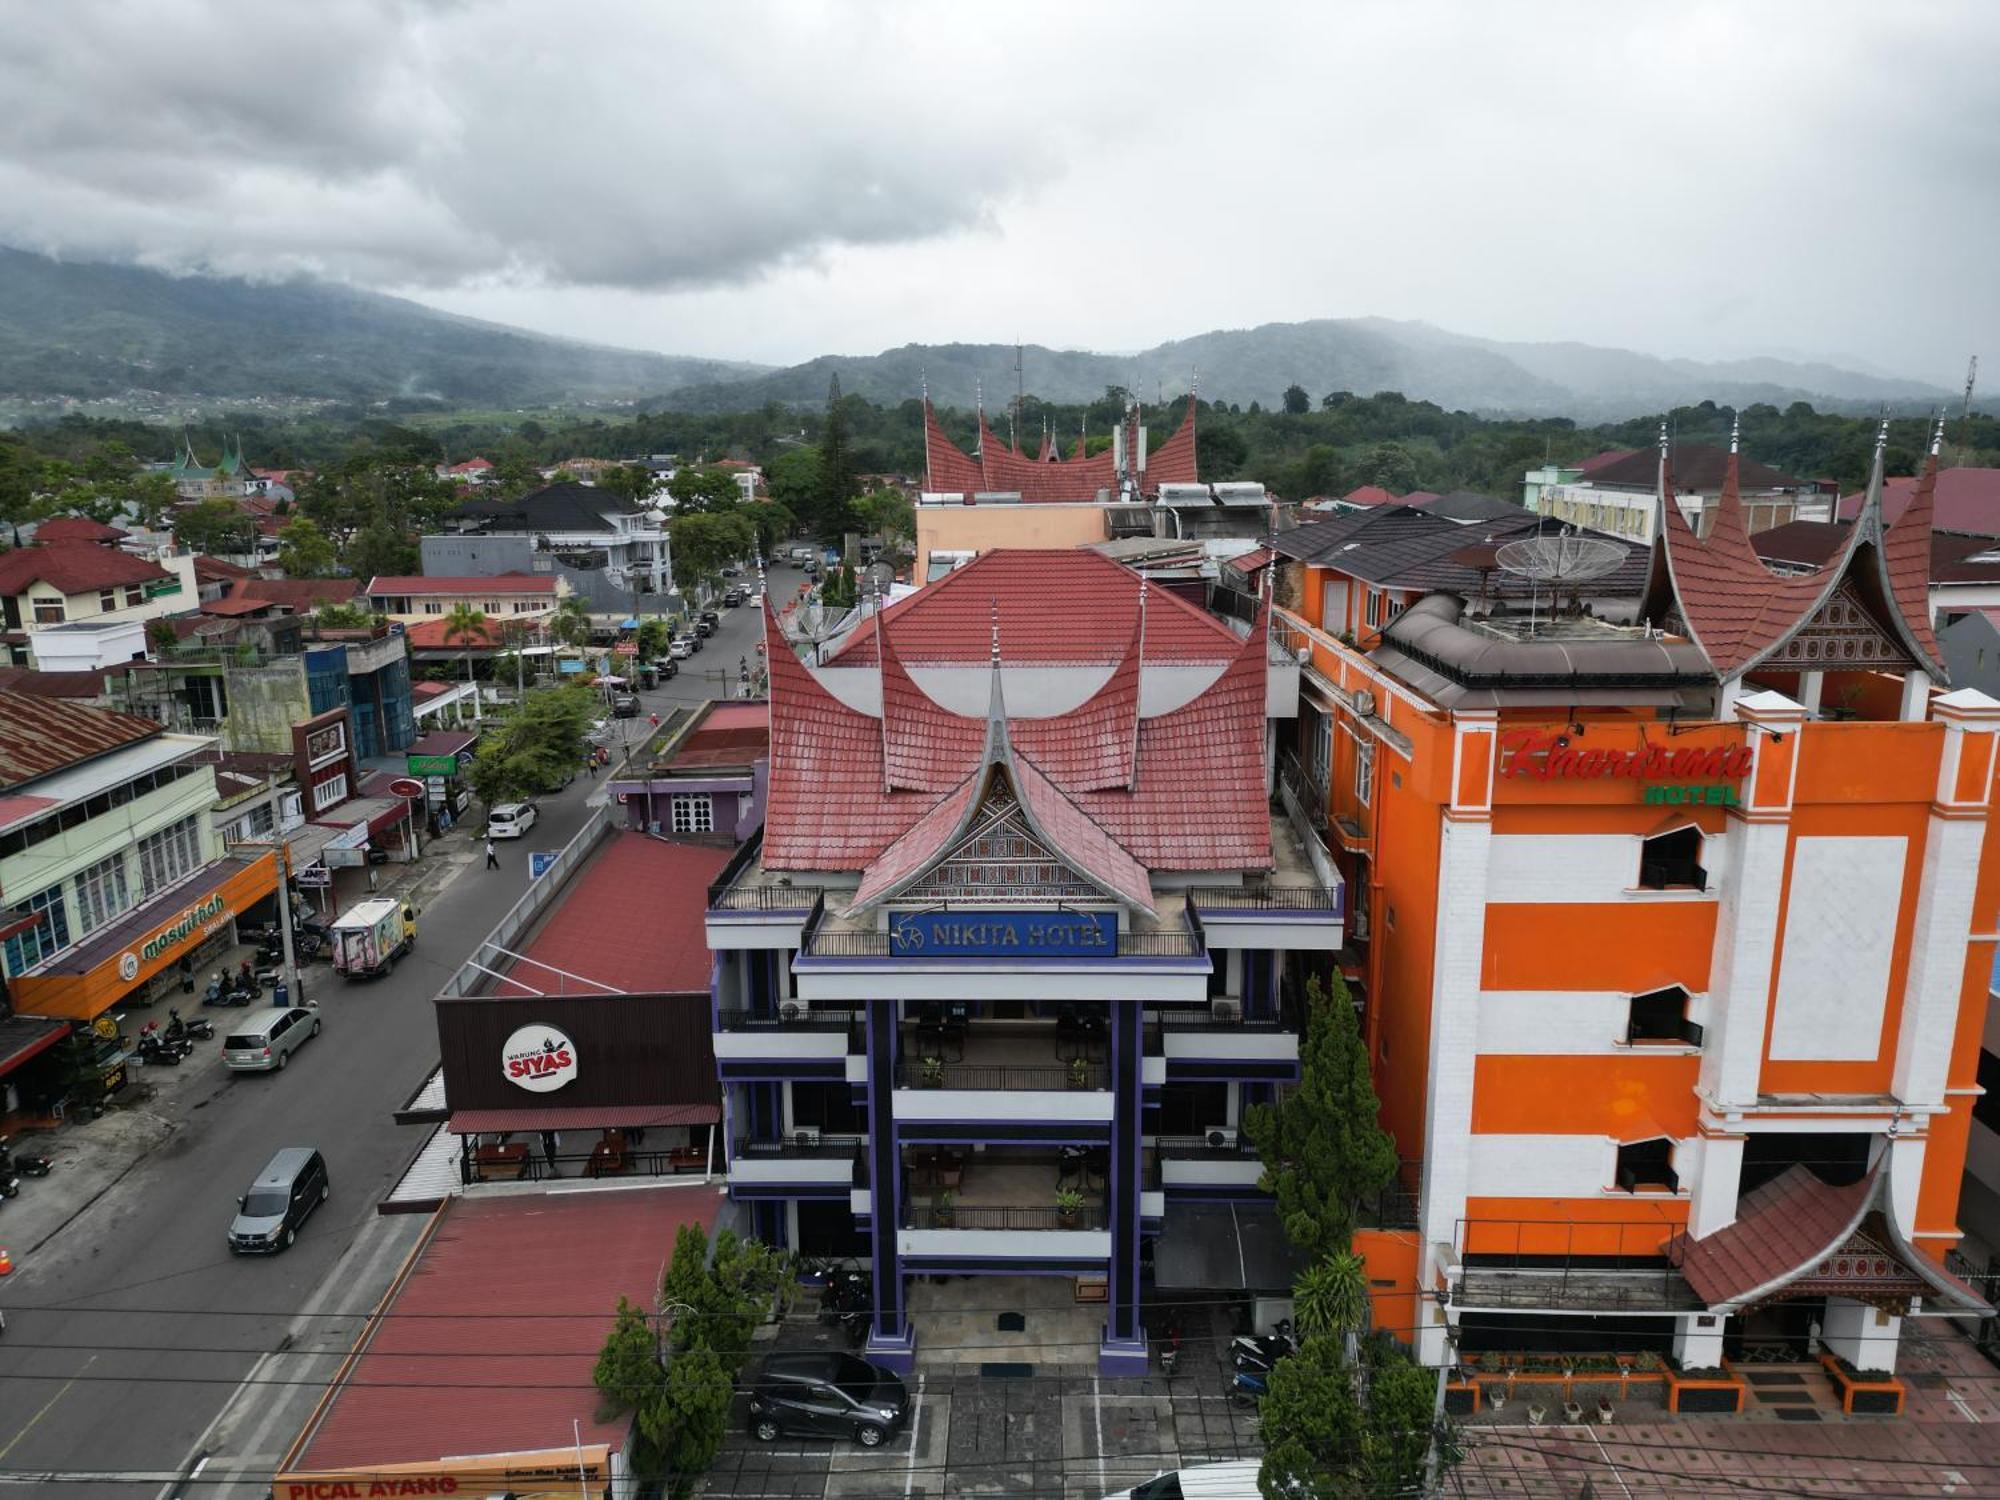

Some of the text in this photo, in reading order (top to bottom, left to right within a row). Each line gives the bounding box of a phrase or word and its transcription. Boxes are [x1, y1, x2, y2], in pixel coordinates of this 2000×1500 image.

[1644, 785, 1742, 806] HOTEL
[933, 923, 1108, 947] NIKITA HOTEL
[507, 1050, 542, 1060] WARUNG
[509, 1050, 572, 1077] SIYAS
[289, 1476, 458, 1500] PICAL AYANG
